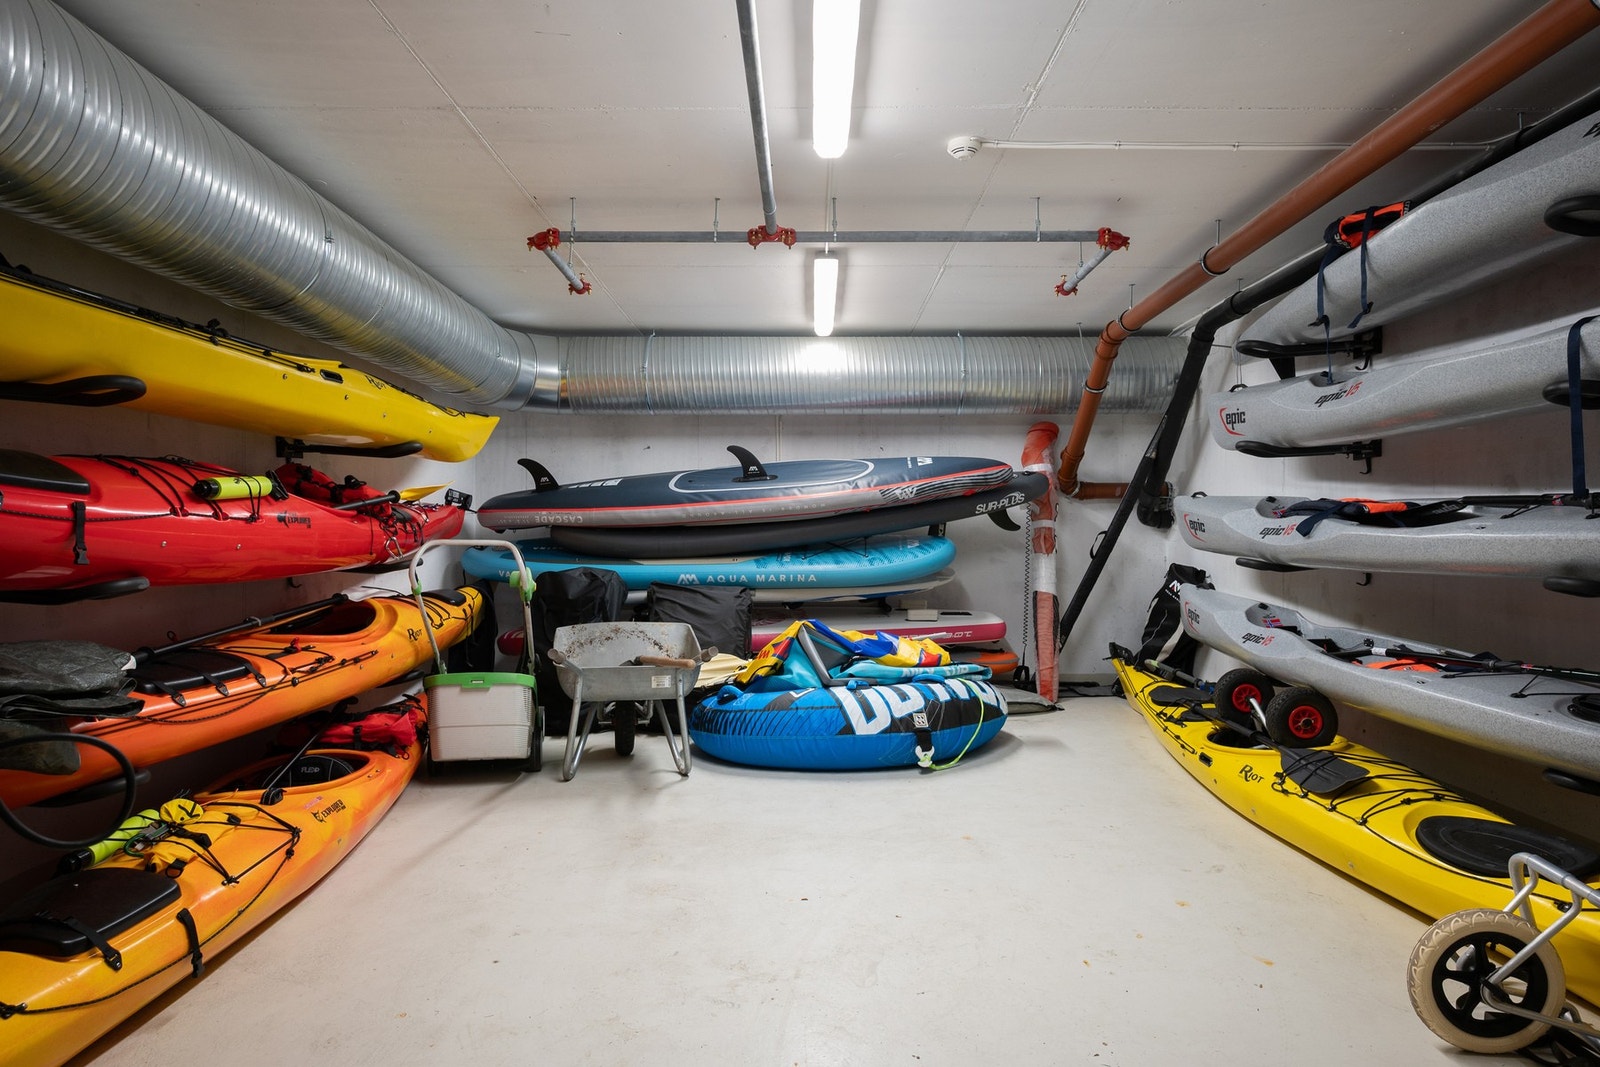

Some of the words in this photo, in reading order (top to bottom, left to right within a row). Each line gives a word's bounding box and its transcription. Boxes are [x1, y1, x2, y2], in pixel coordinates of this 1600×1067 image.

[1225, 408, 1246, 431] epic
[975, 493, 1025, 514] SUR-PLUS
[535, 515, 584, 524] CASCADE
[1188, 518, 1206, 535] epic
[706, 575, 749, 584] AQUA
[756, 573, 817, 583] MARINA
